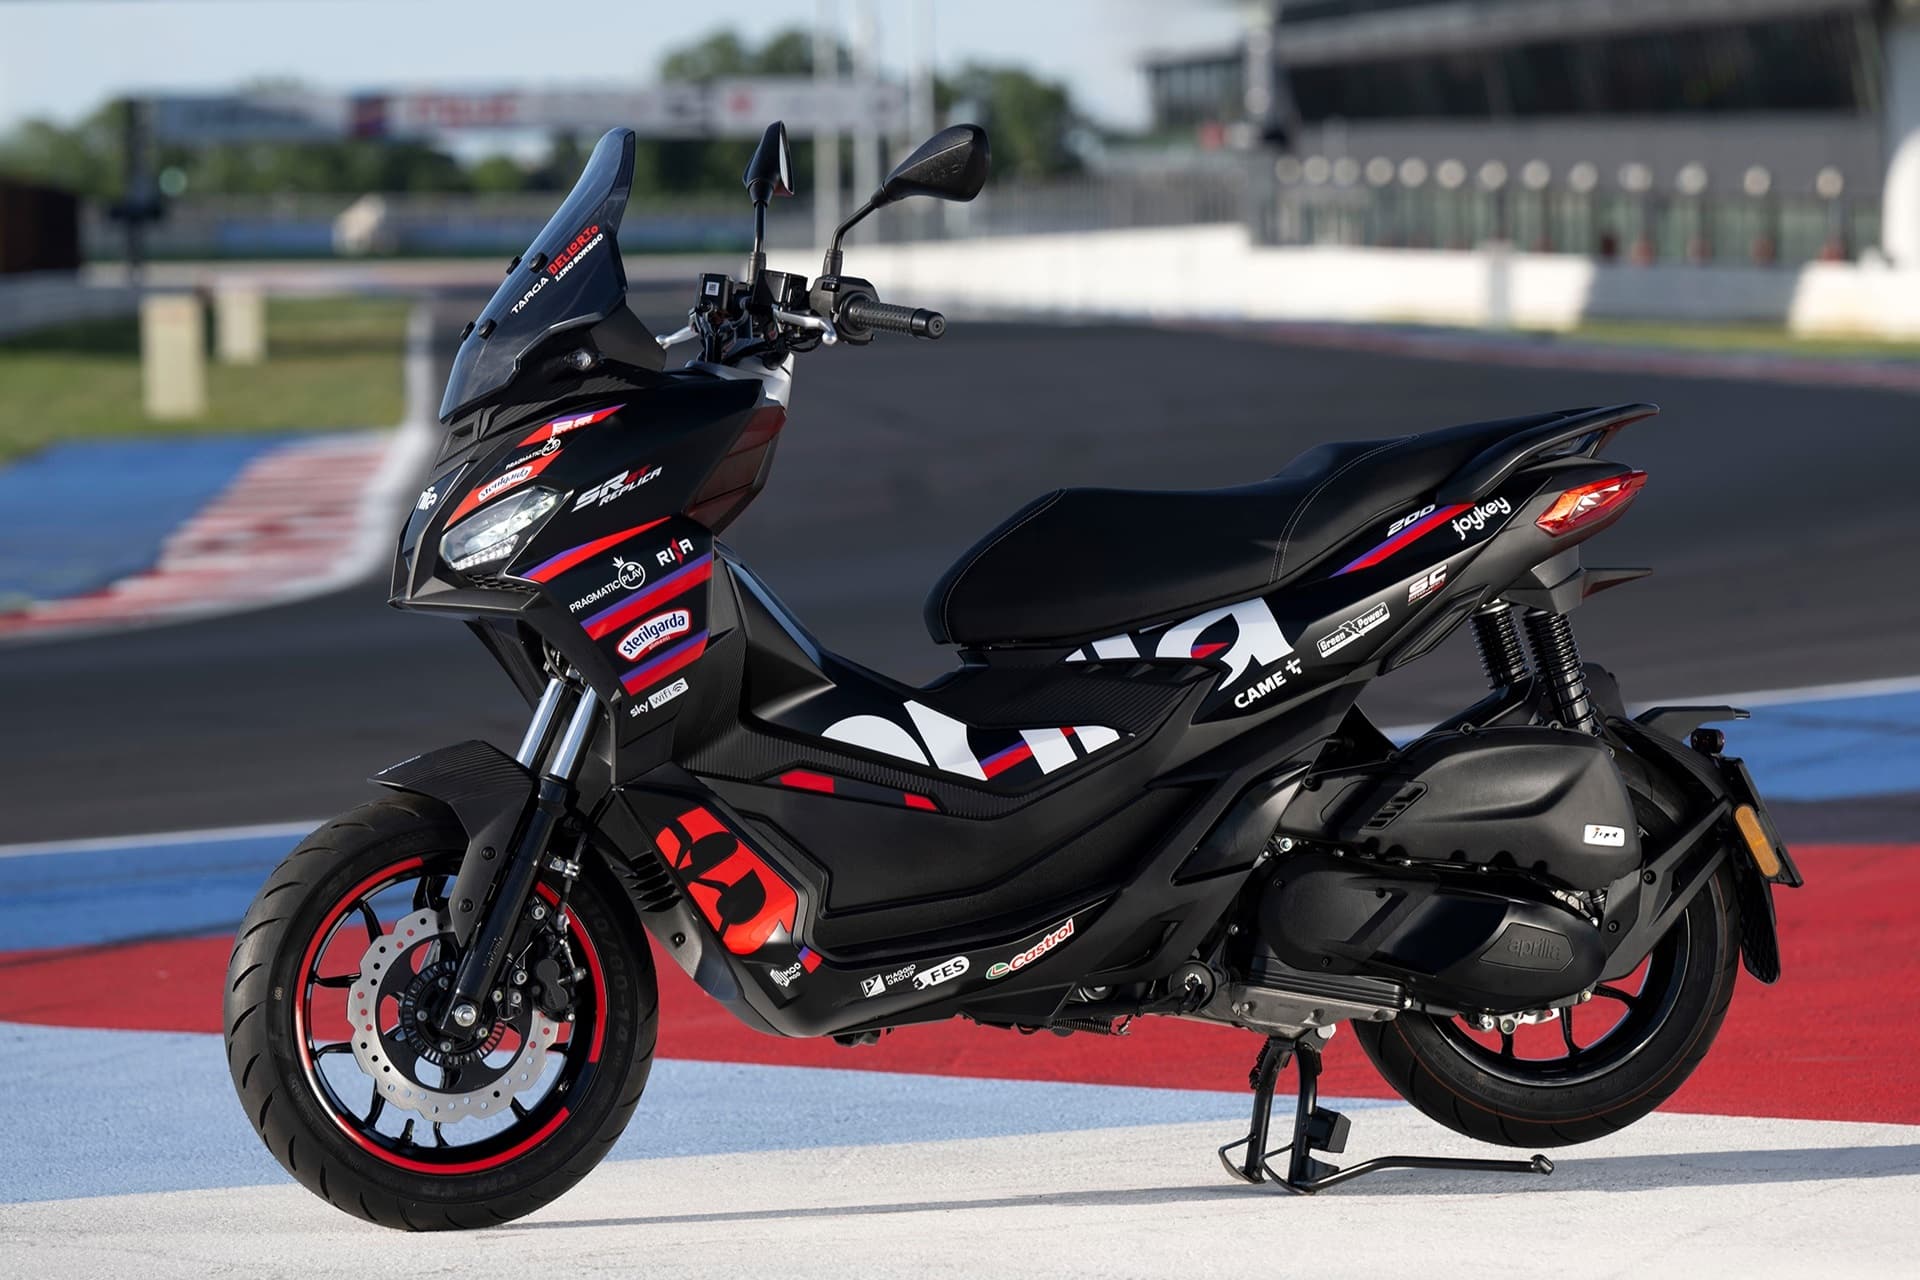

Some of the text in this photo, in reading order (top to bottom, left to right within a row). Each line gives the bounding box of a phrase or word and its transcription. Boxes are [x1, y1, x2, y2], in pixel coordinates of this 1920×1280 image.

[554, 262, 575, 282] LINO
[510, 276, 549, 314] TARGA
[571, 469, 629, 512] SR
[599, 466, 662, 507] REPLICA
[1386, 504, 1436, 537] 200
[1452, 497, 1511, 541] joykey
[569, 567, 642, 613] PRAGMATIC PLAY
[1408, 564, 1448, 597] SC
[623, 613, 686, 655] sterilgarda
[1320, 607, 1384, 651] Green Power
[1233, 669, 1287, 709] CAME
[629, 701, 650, 718] sky
[1009, 917, 1075, 972] Castrol
[1507, 933, 1560, 961] aprilia
[885, 964, 917, 982] PIAGGIO
[887, 970, 915, 986] GROUP
[930, 960, 965, 982] FES
